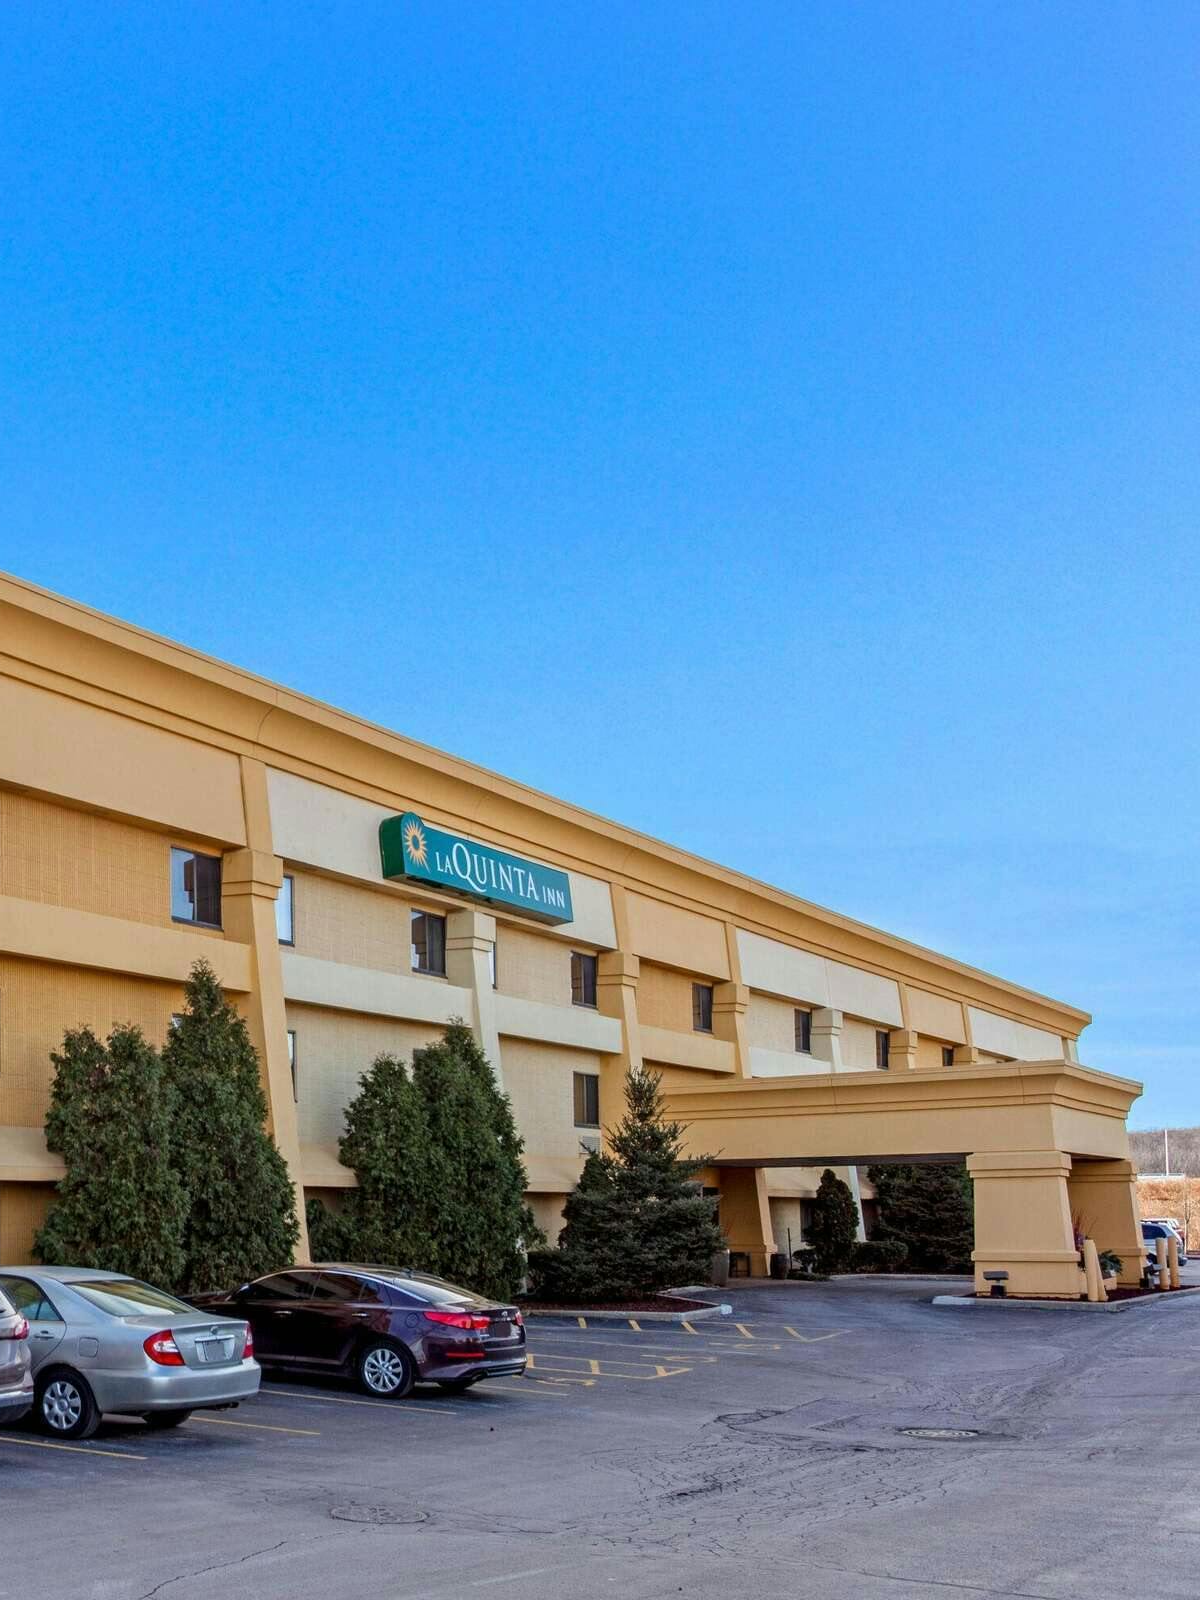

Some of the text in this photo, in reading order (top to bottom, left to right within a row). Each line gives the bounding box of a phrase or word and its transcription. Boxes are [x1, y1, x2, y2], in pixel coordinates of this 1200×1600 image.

[435, 842, 565, 909] LA QUINTA INN
